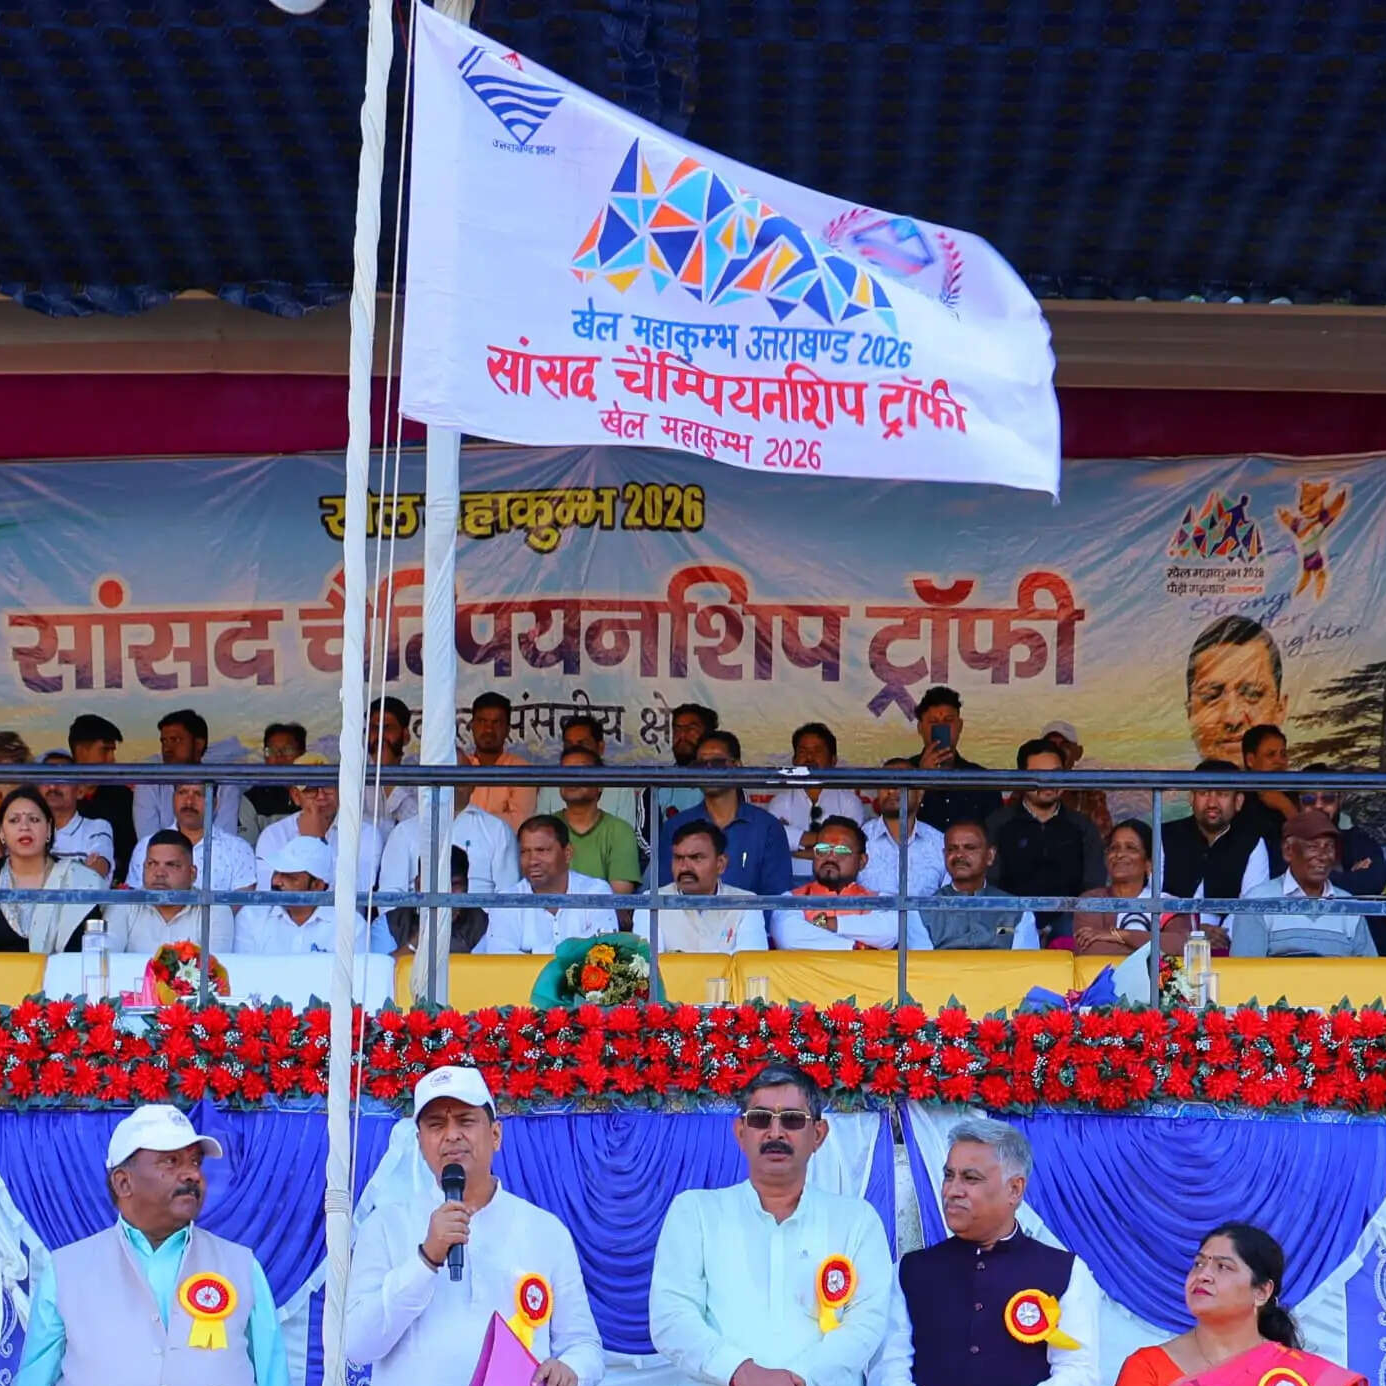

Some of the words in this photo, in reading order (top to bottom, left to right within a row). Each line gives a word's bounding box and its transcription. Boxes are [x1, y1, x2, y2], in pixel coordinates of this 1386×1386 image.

[572, 298, 619, 343] खेल
[633, 314, 737, 362] महाकुम्भ
[745, 325, 855, 364] उत्तराखण्ड
[858, 332, 912, 370] 2026
[486, 336, 601, 402] सांसद
[613, 345, 867, 431] चैम्पियनशिप
[878, 377, 967, 439] ट्रॉफी
[600, 401, 645, 440] खेल
[661, 414, 752, 464] महाकुम्भ
[765, 438, 822, 470] 2026
[431, 487, 617, 552] हाकुम्भ
[622, 483, 704, 531] 2026
[9, 573, 284, 694] सांसद
[866, 571, 1086, 720] ट्रॉफी
